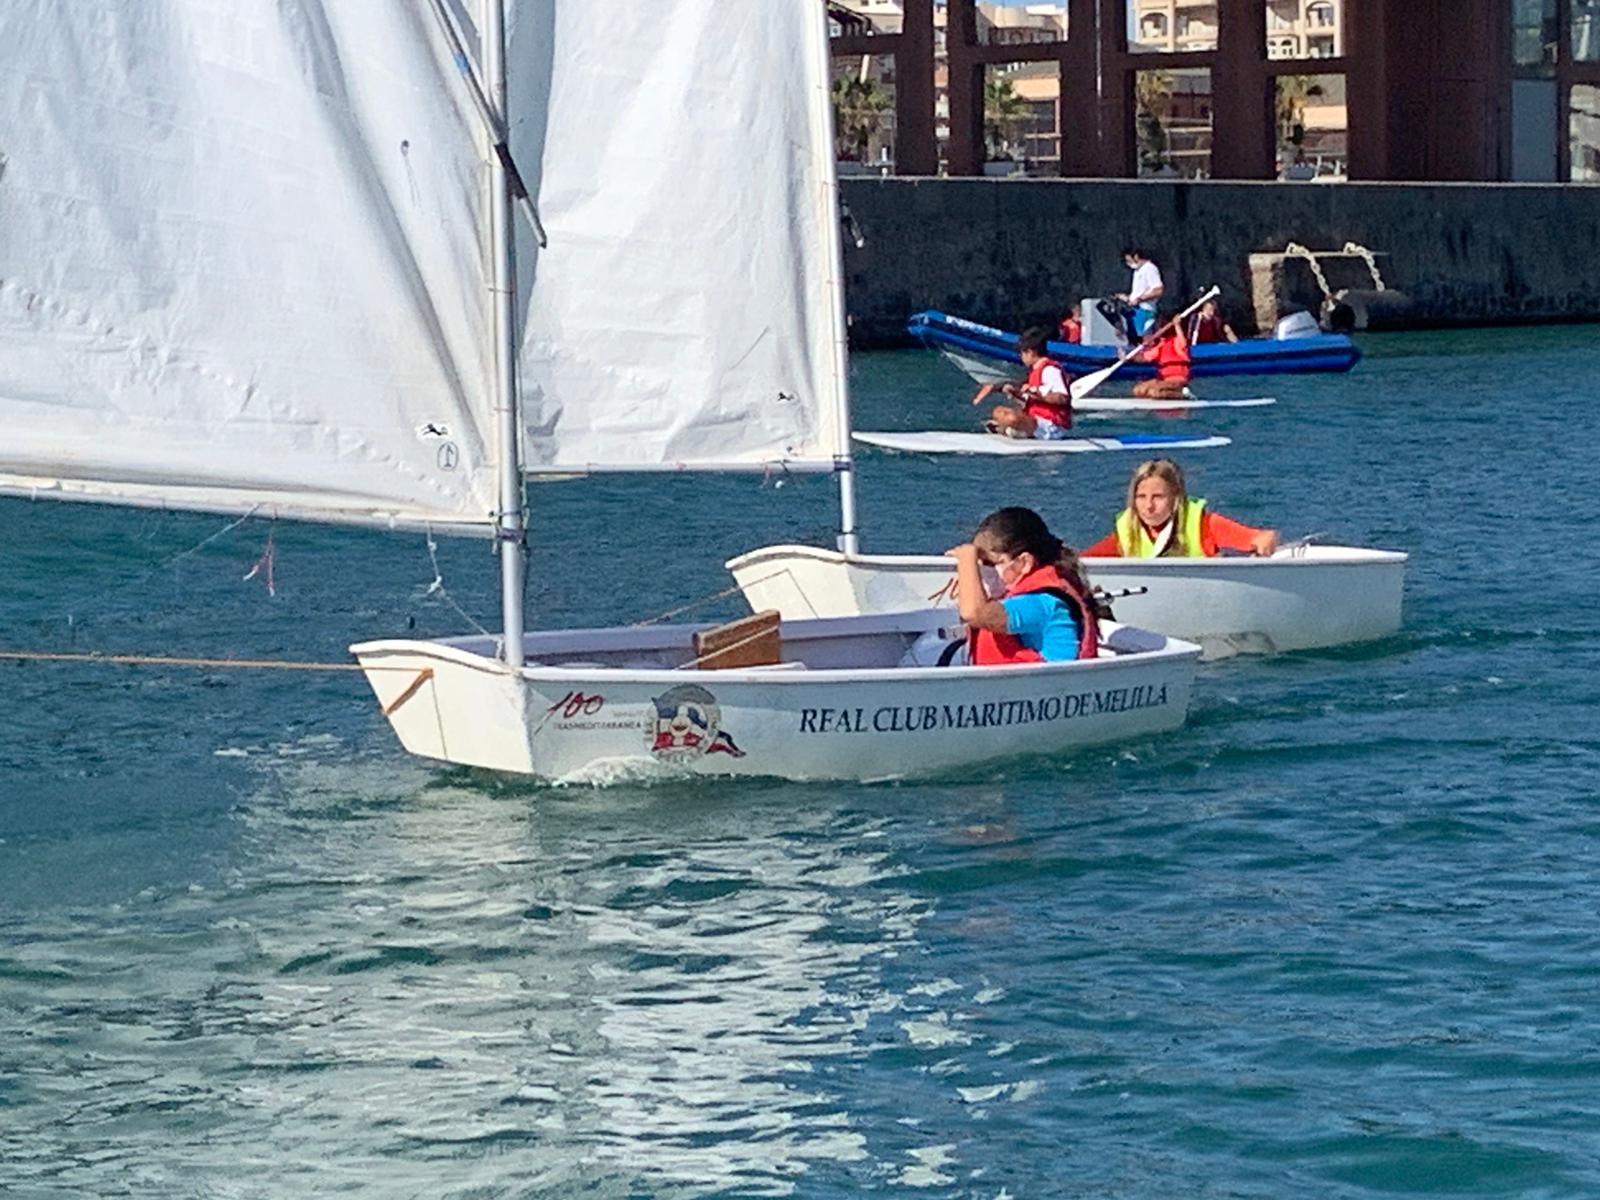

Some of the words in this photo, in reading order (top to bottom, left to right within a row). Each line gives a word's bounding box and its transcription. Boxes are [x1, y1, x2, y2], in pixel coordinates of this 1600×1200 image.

[538, 691, 604, 728] 100
[800, 708, 868, 733] REAL
[873, 705, 938, 732] CLUB
[940, 696, 1061, 729] MARITIMO
[1063, 691, 1093, 719] DE
[1092, 682, 1168, 714] MELILLA
